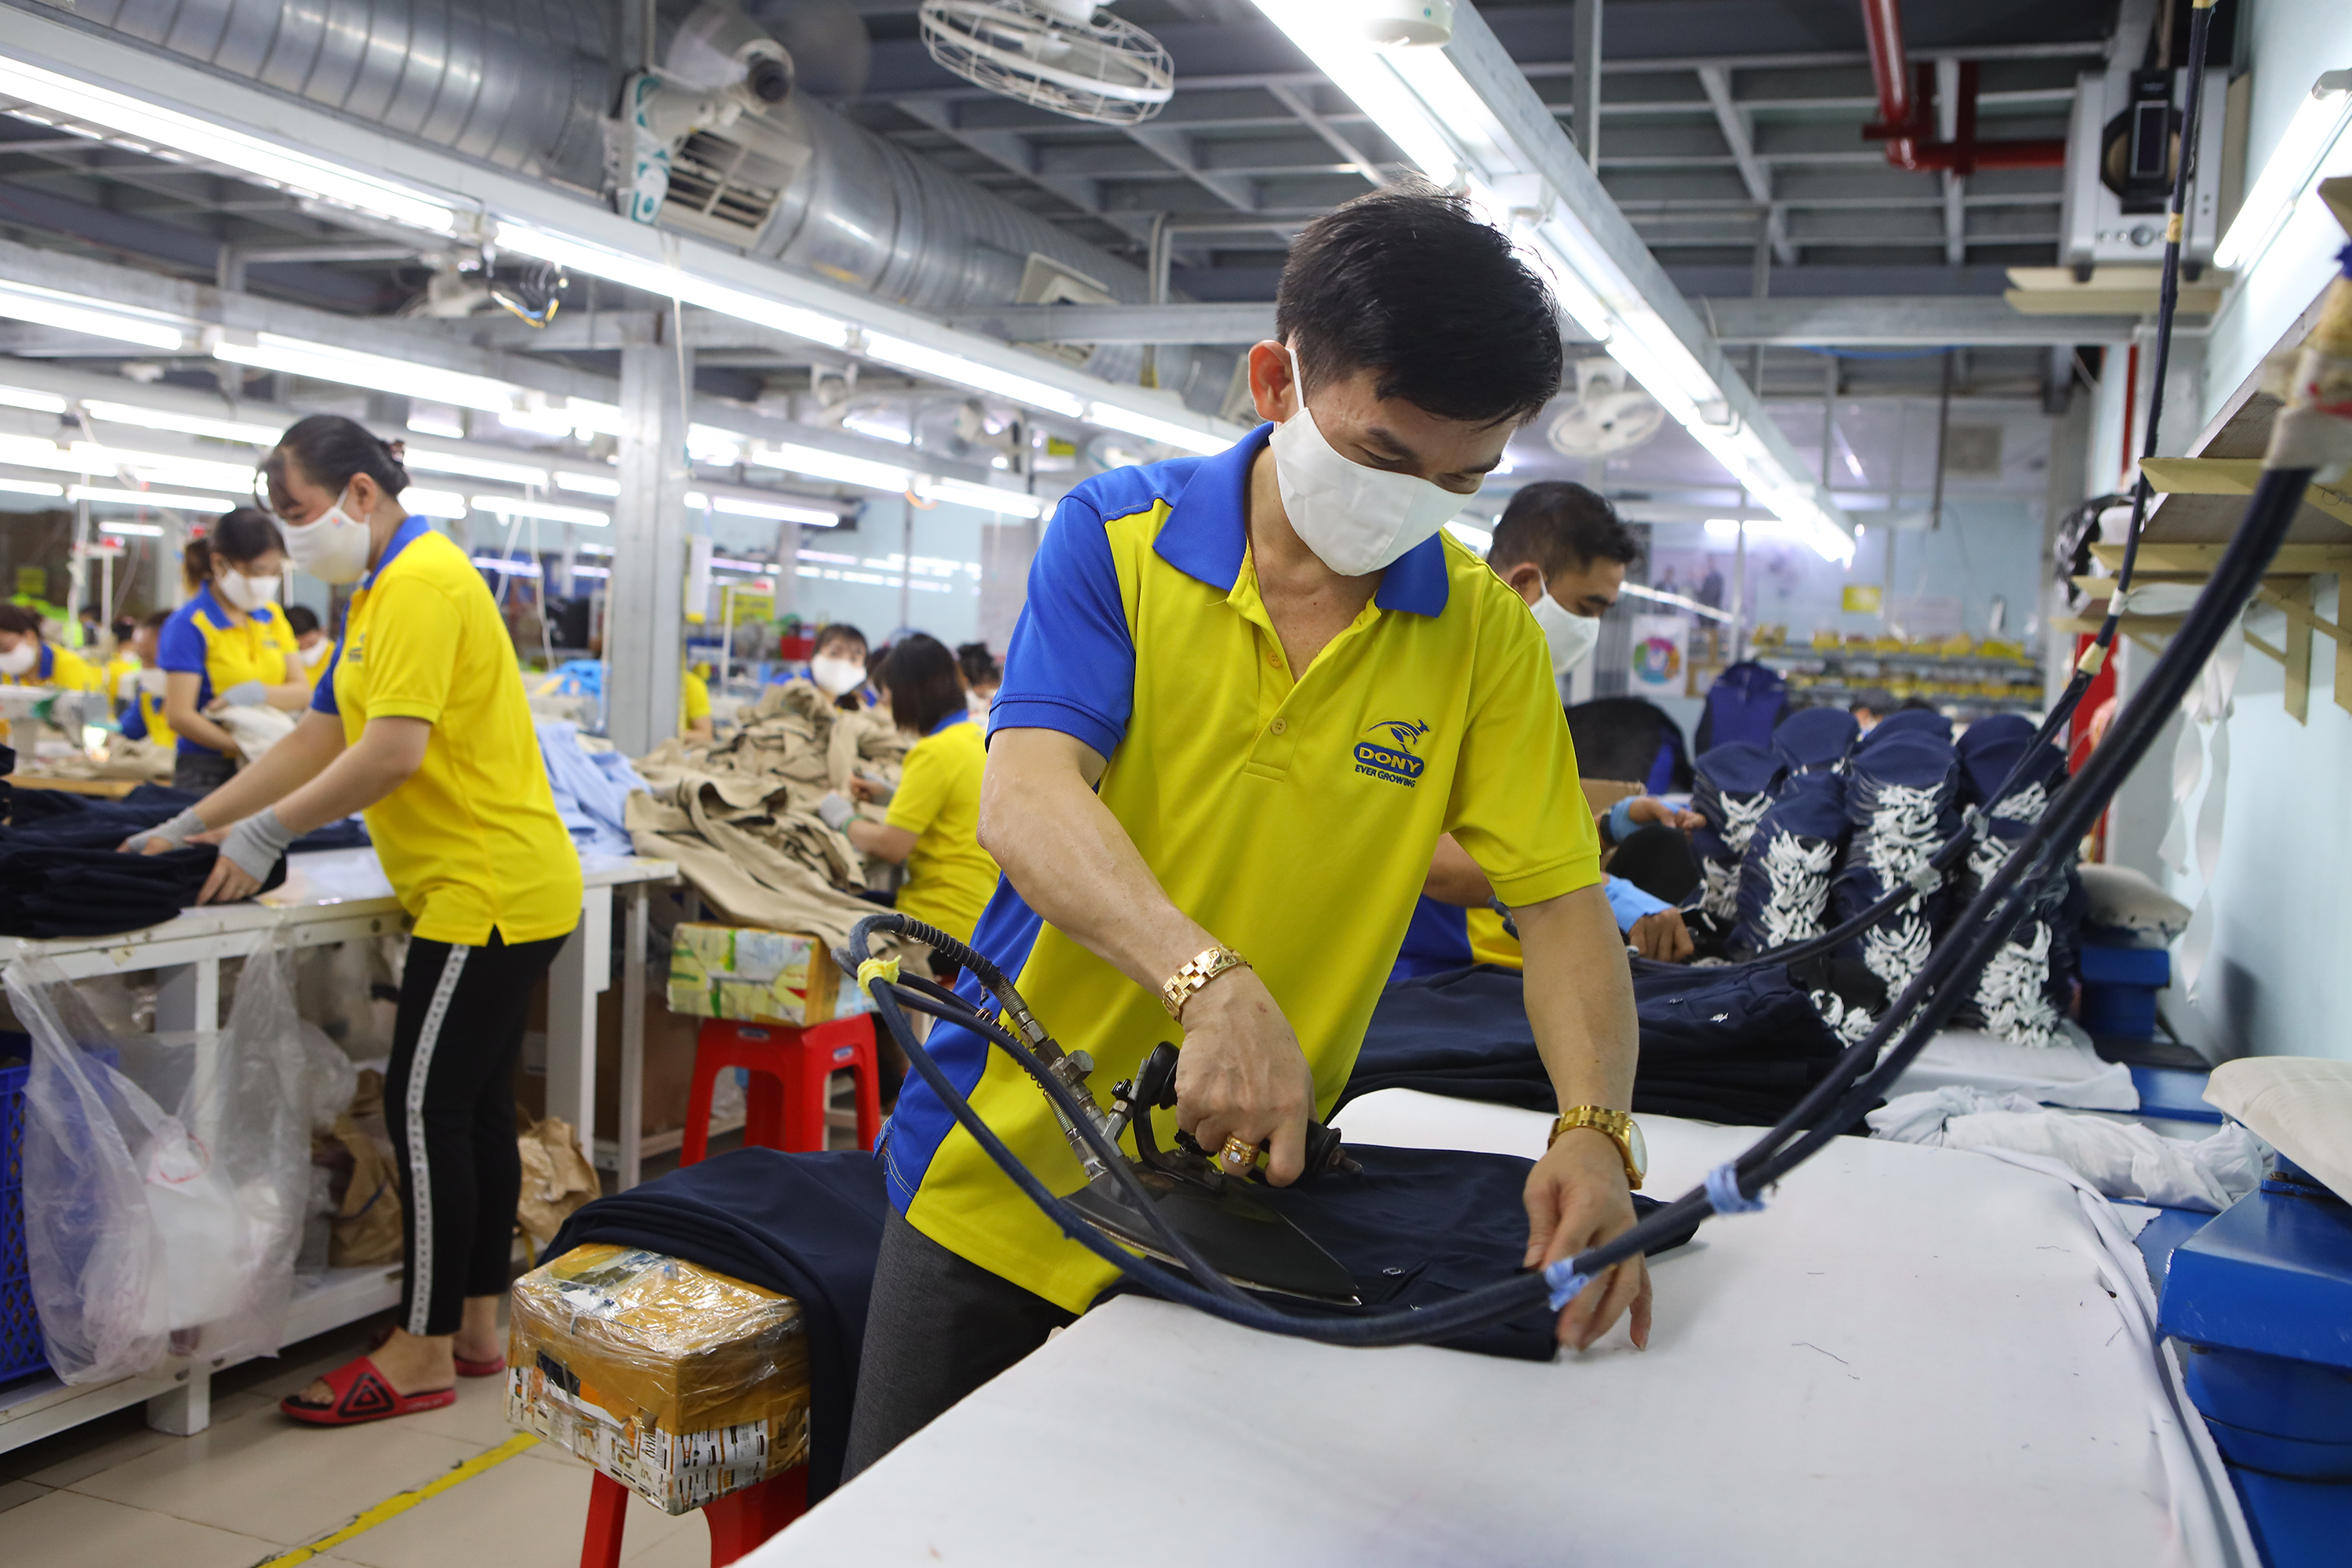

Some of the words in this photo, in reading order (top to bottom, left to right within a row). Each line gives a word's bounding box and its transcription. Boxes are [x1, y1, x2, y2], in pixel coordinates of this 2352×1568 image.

[1359, 746, 1421, 773] DONY
[1355, 764, 1377, 777] EVER
[1377, 770, 1417, 788] GROWING
